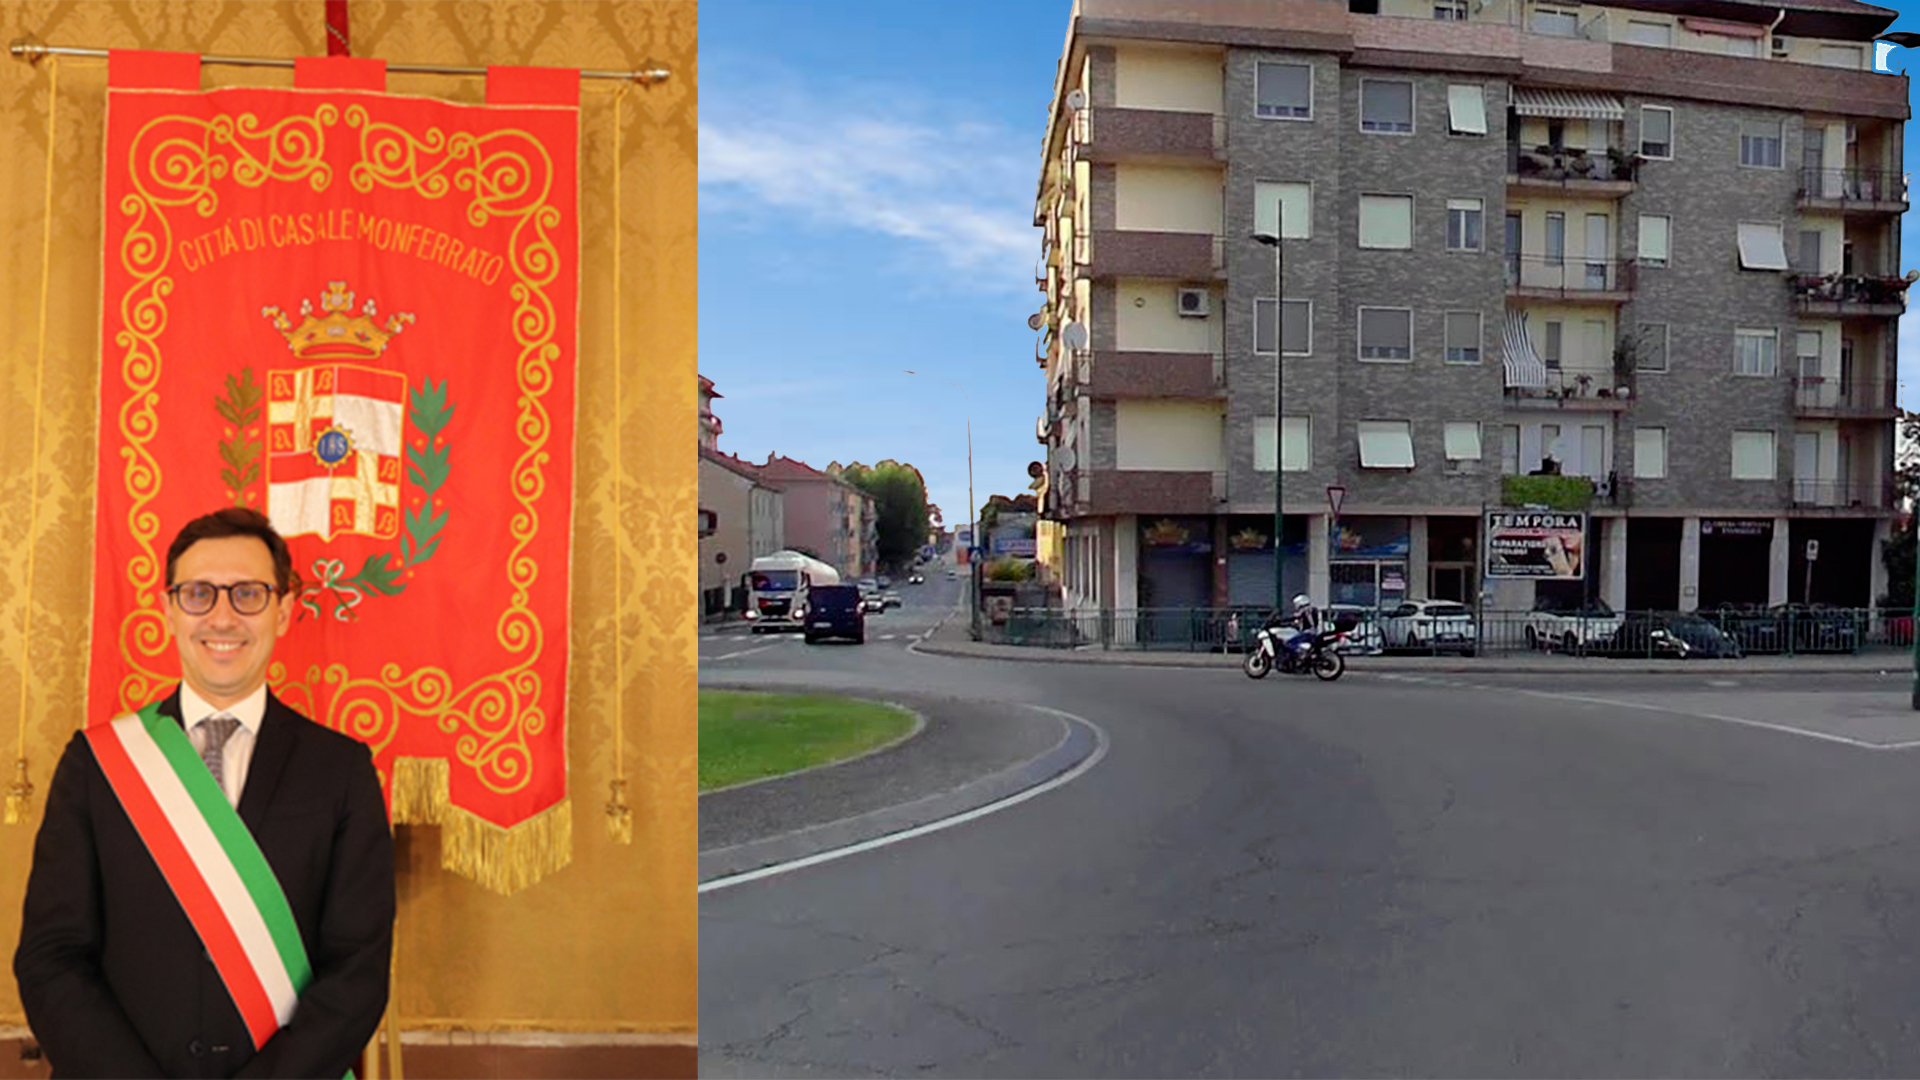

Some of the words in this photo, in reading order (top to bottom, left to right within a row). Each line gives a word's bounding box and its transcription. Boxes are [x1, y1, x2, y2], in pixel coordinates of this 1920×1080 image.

[240, 217, 265, 250] DI
[269, 208, 353, 248] CASALE
[357, 212, 504, 286] MONFERRATO
[1492, 515, 1578, 528] TEMPORA
